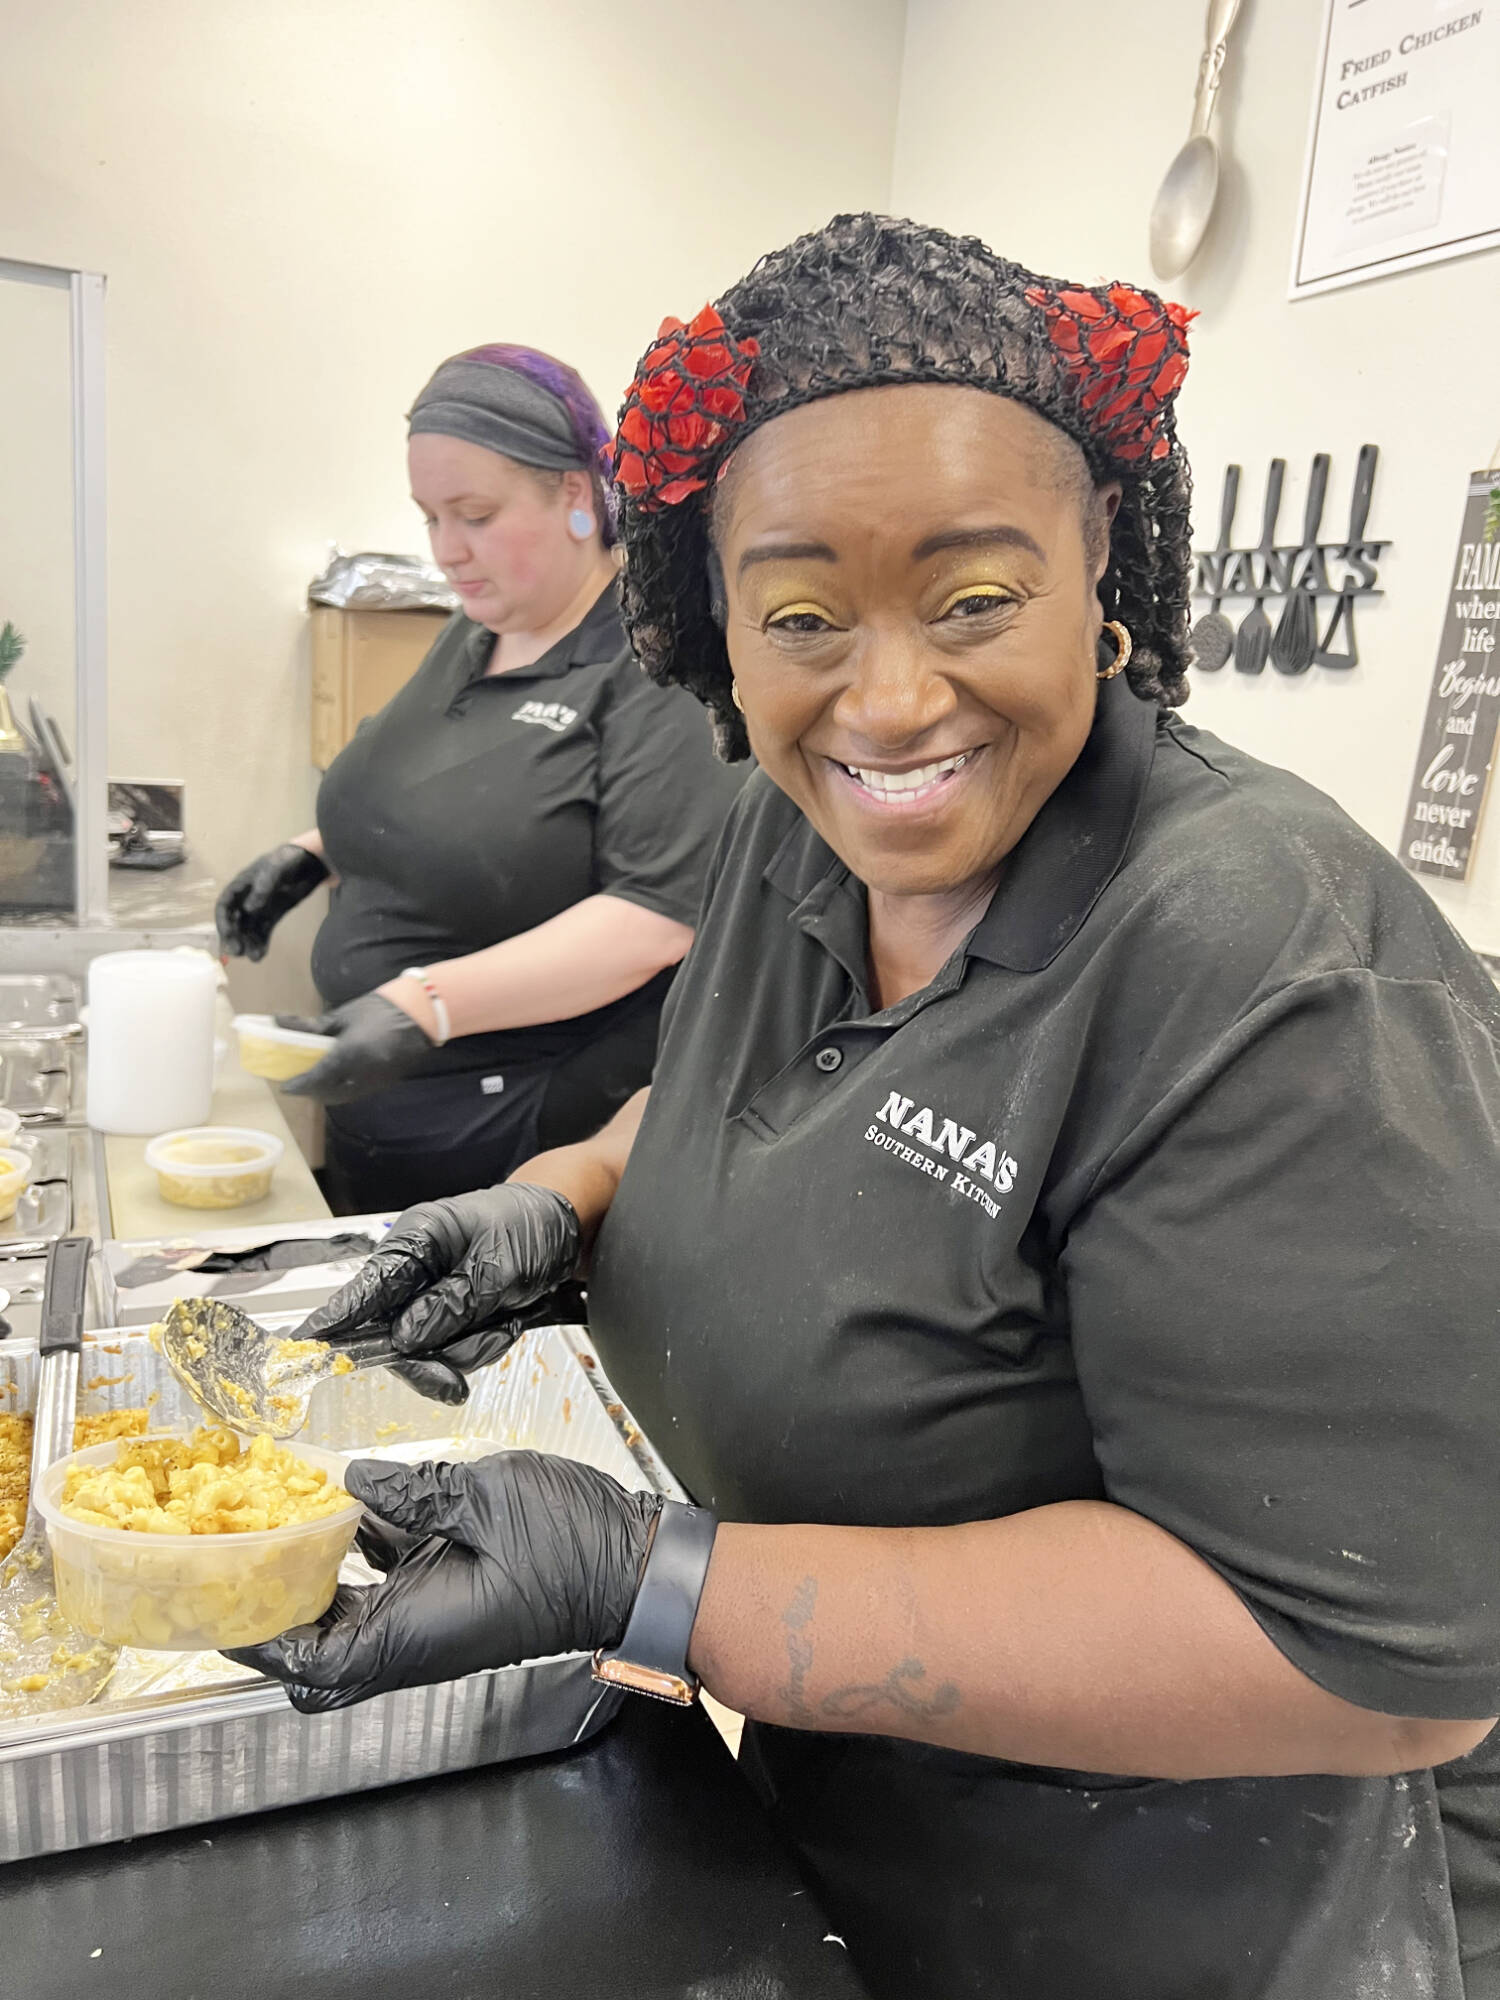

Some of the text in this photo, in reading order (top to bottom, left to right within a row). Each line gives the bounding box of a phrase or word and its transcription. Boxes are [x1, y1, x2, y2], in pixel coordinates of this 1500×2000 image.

[1340, 8, 1484, 81] FRIED CHICKEN
[1336, 71, 1409, 110] CATFISH
[1192, 543, 1380, 597] NANA'S
[1461, 627, 1496, 653] life
[1445, 710, 1477, 735] and
[1421, 743, 1479, 796] love
[1413, 801, 1472, 828] never
[1408, 836, 1460, 868] ends.
[864, 1124, 949, 1181] SOUTHERN
[875, 1090, 1018, 1193] NANA'S
